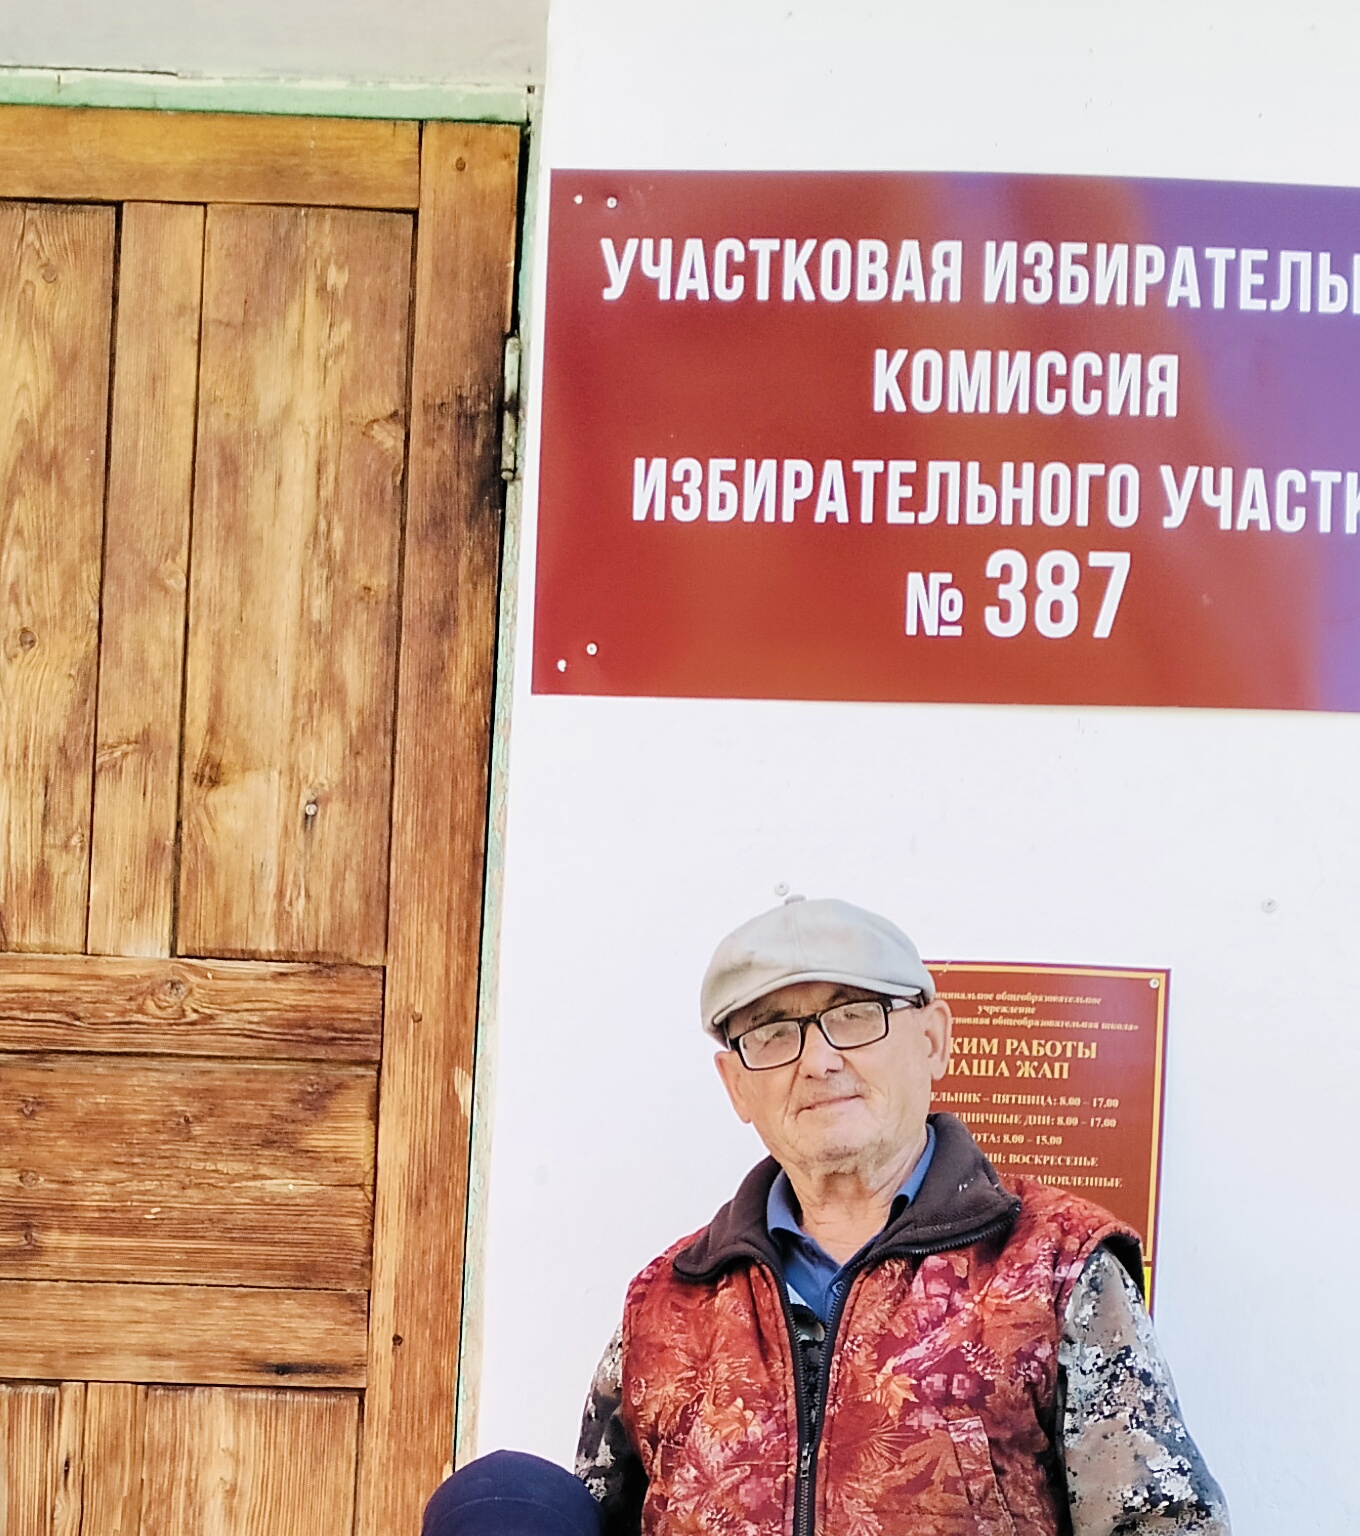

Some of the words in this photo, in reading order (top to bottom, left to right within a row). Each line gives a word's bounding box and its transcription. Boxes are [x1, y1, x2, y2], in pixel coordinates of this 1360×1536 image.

[600, 236, 964, 305] УЧАСТКОВАЯ
[872, 348, 1181, 418] КОМИССИЯ
[632, 457, 1141, 529] ИЗБИРАТЕЛЬНОГО
[904, 569, 963, 637] №
[983, 549, 1132, 640] 387
[1005, 1038, 1098, 1060] РАБОТЫ
[1016, 1060, 1070, 1079] ЖАП
[992, 1093, 1057, 1107] ПЯТНИЦА:
[1092, 1097, 1120, 1108] 17.00
[1090, 1117, 1117, 1128] 17.00
[1009, 1154, 1099, 1167] ВОСКРЕСЕНЬЕ
